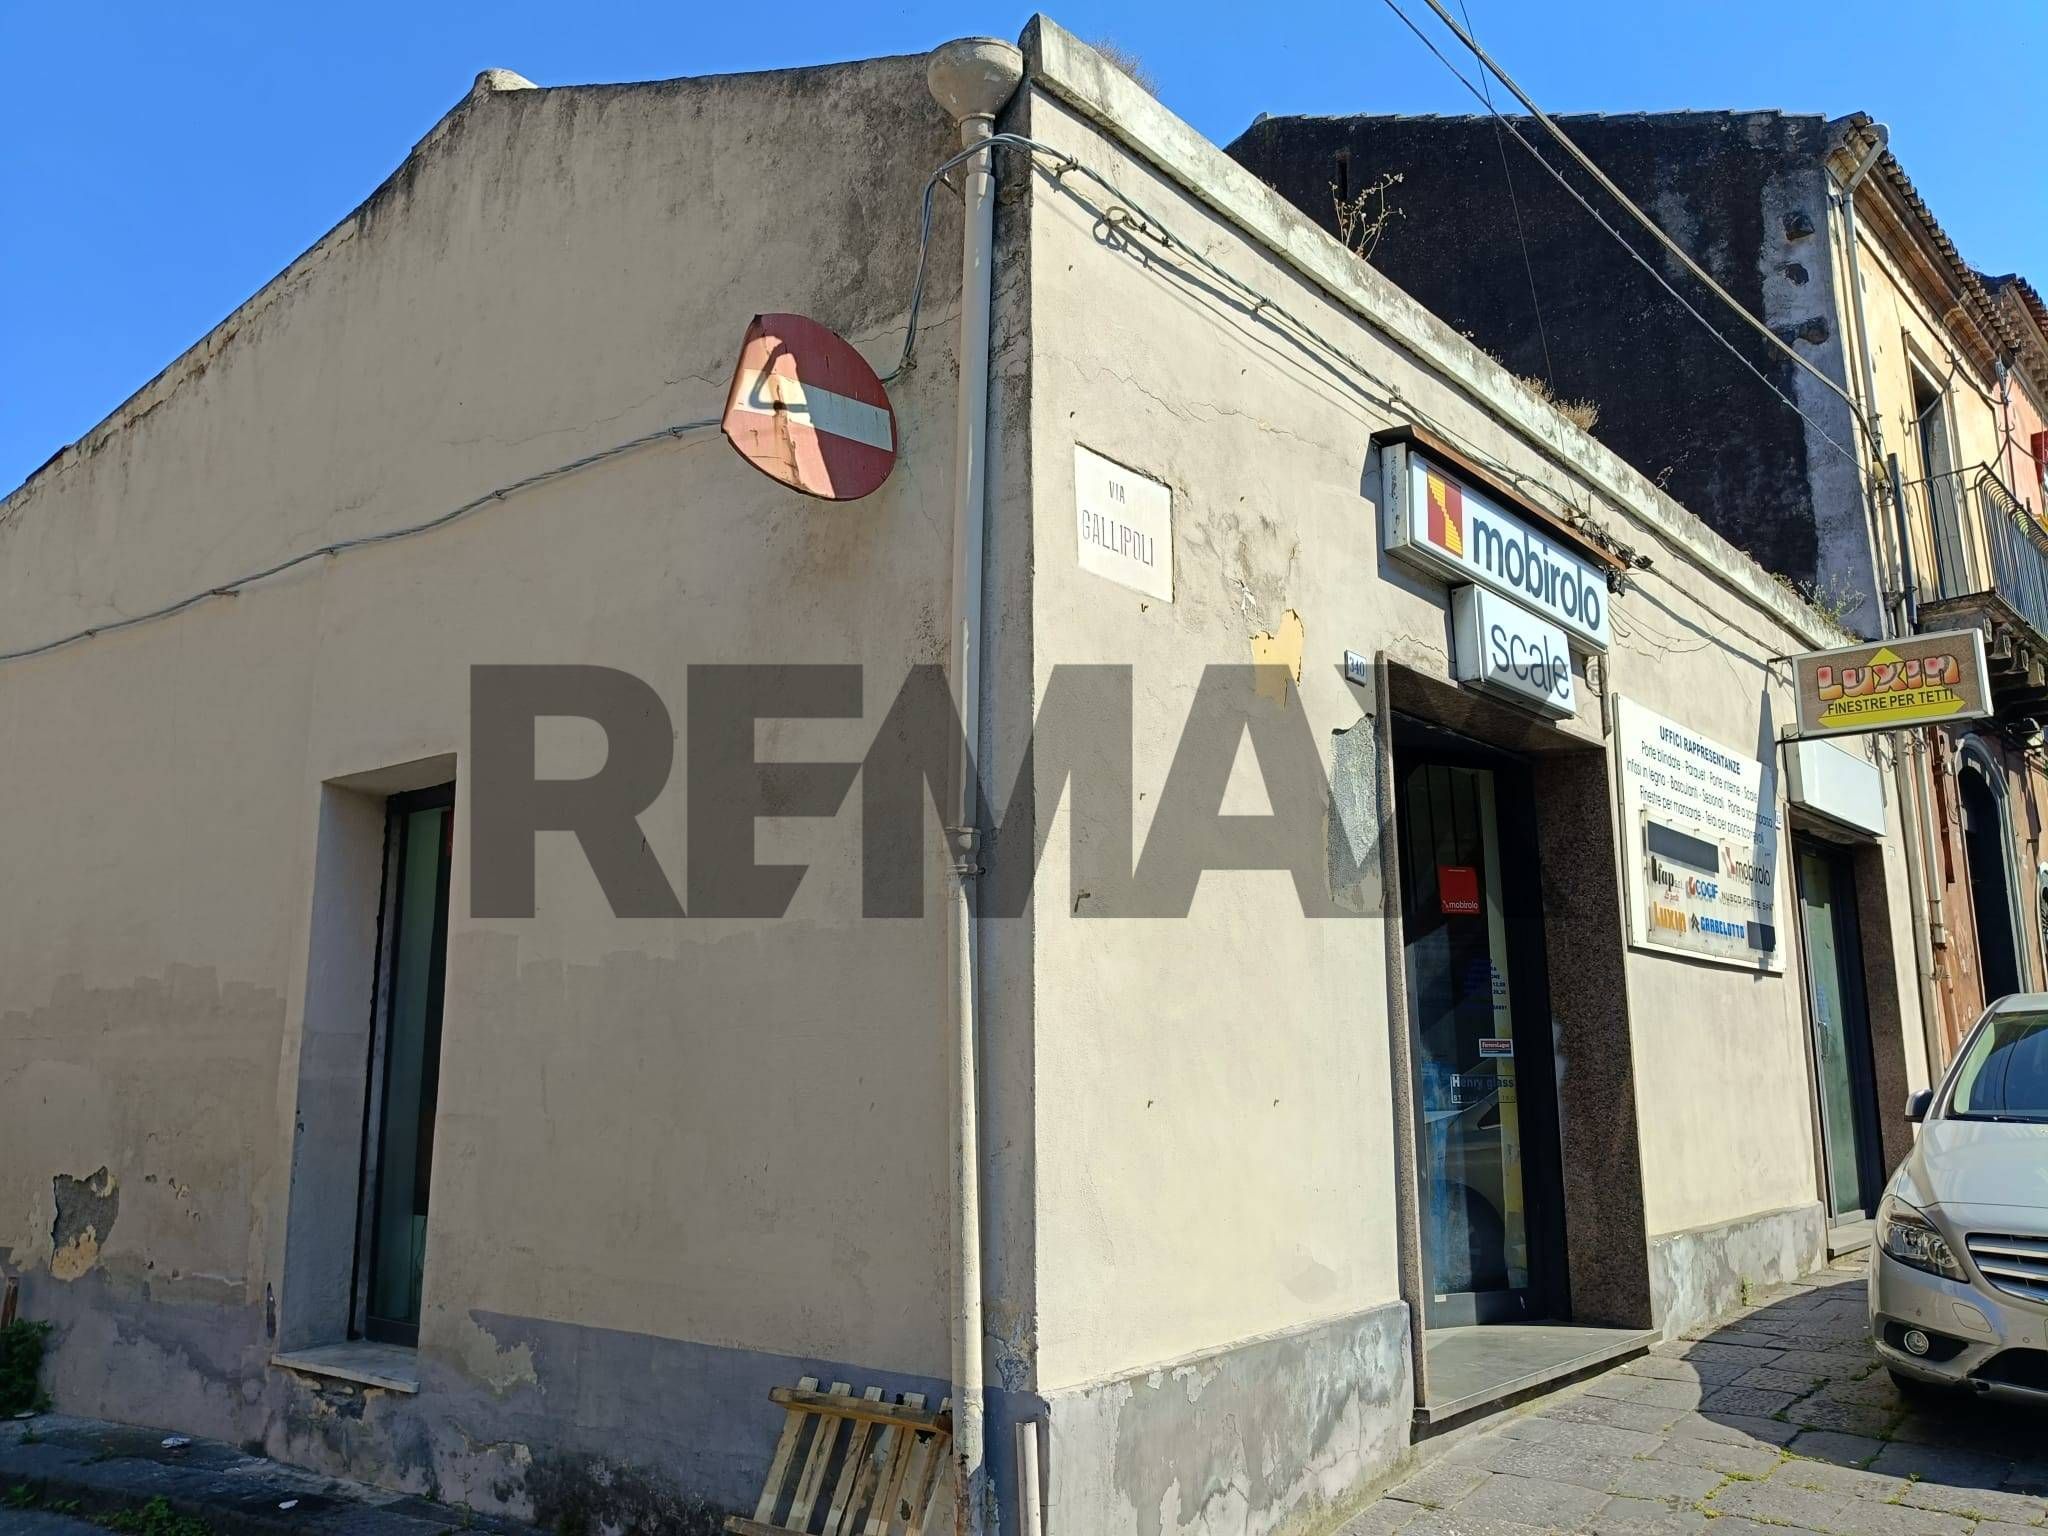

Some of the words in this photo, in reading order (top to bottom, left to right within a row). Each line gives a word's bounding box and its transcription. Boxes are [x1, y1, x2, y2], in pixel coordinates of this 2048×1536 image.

[1109, 480, 1125, 505] VIA
[1082, 509, 1154, 567] GALLIPOLI
[1472, 515, 1600, 631] mobirolo
[1349, 656, 1365, 677] 340
[1490, 623, 1571, 700] scale
[1827, 693, 1888, 715] FINESTRE
[1889, 692, 1915, 708] PER
[1919, 688, 1954, 704] TETTI
[1641, 741, 1656, 760] Porte
[1659, 725, 1683, 749] UFFICI
[1683, 737, 1741, 775] RAPPRESENTANZE
[1735, 860, 1771, 887] mobirolo
[1695, 879, 1719, 899] COCIF
[1448, 900, 1479, 910] mobirolo
[1700, 916, 1745, 938] GARBELOTTO
